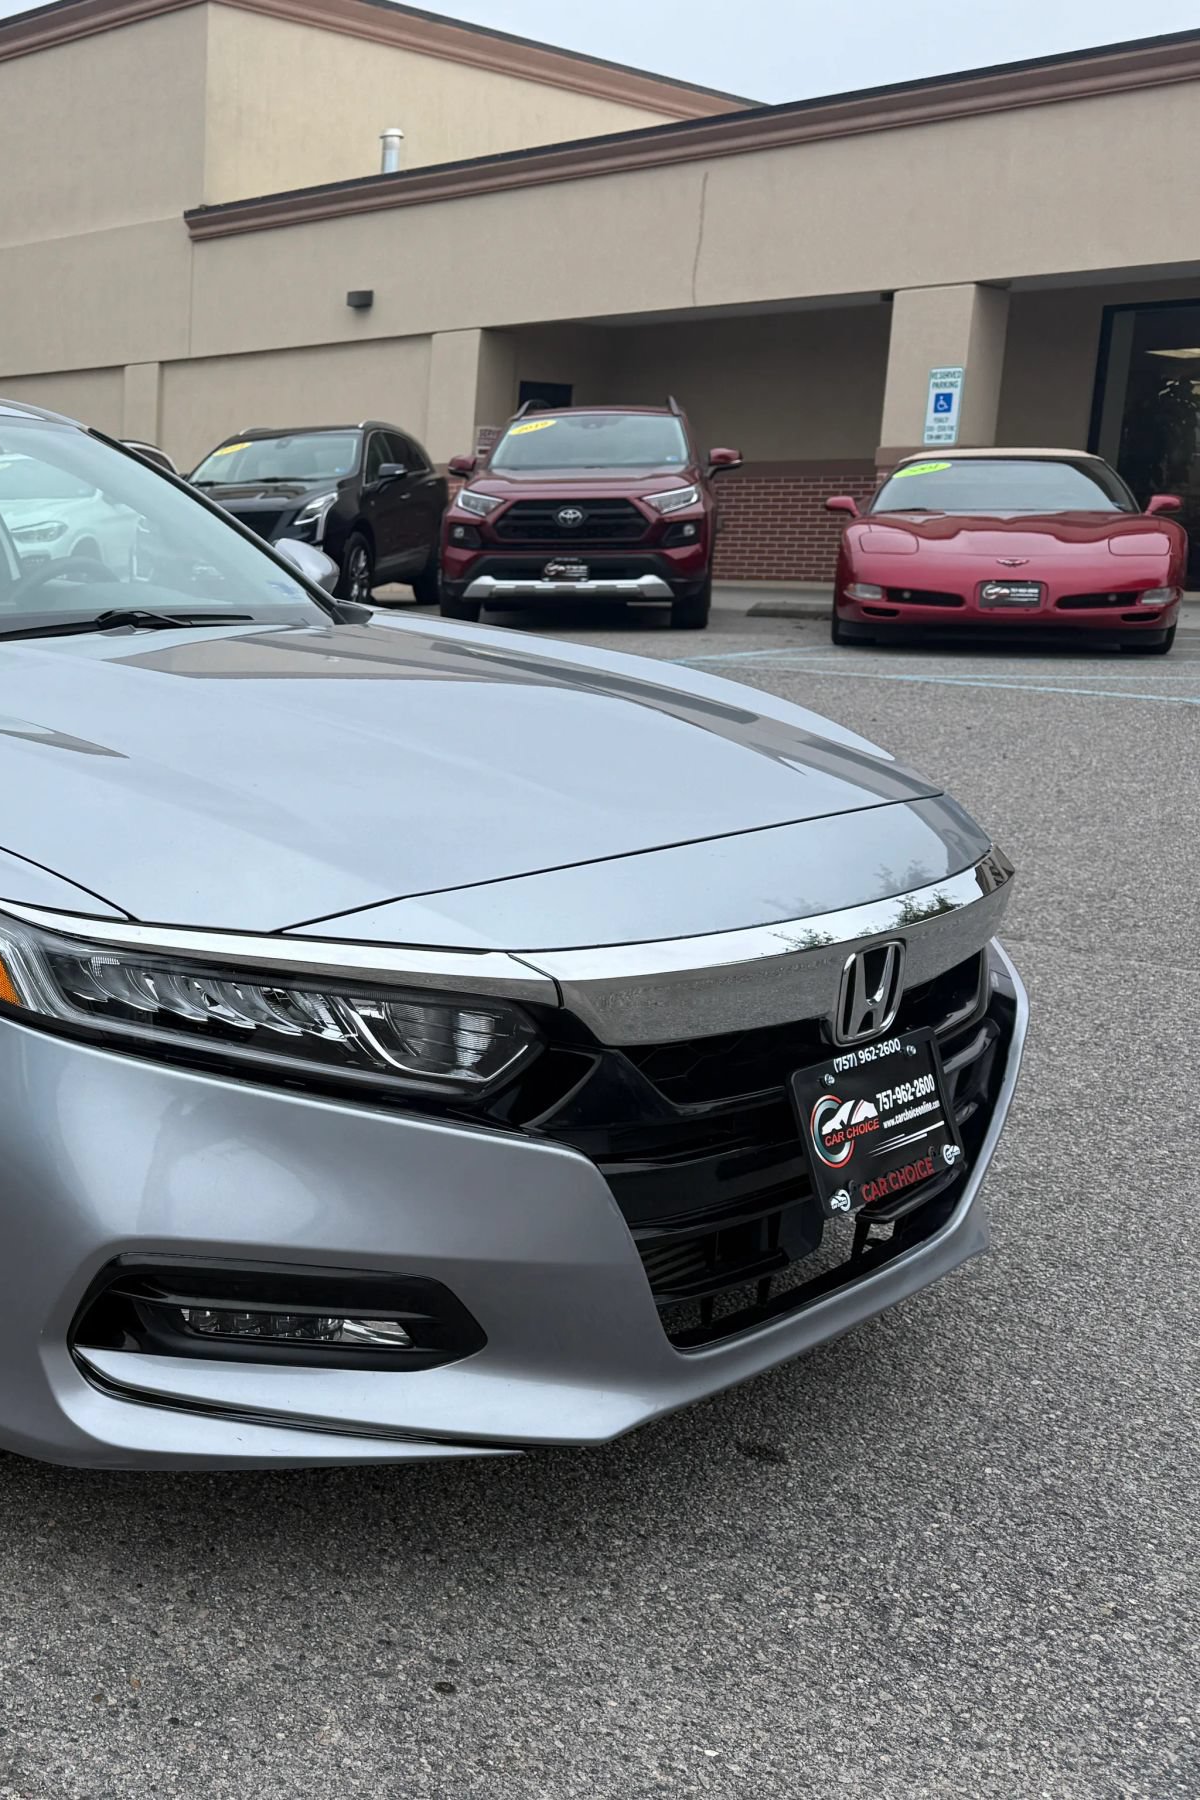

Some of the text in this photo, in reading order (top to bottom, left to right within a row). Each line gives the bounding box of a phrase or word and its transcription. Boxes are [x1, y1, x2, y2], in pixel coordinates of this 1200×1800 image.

[834, 1038, 901, 1073] (757) 962-2600
[876, 1073, 935, 1112] 757-962-2600
[883, 1100, 940, 1129] www.carchoiceonline.com
[825, 1118, 880, 1147] CAR CHOICE
[861, 1157, 935, 1202] CAR CHOICE
